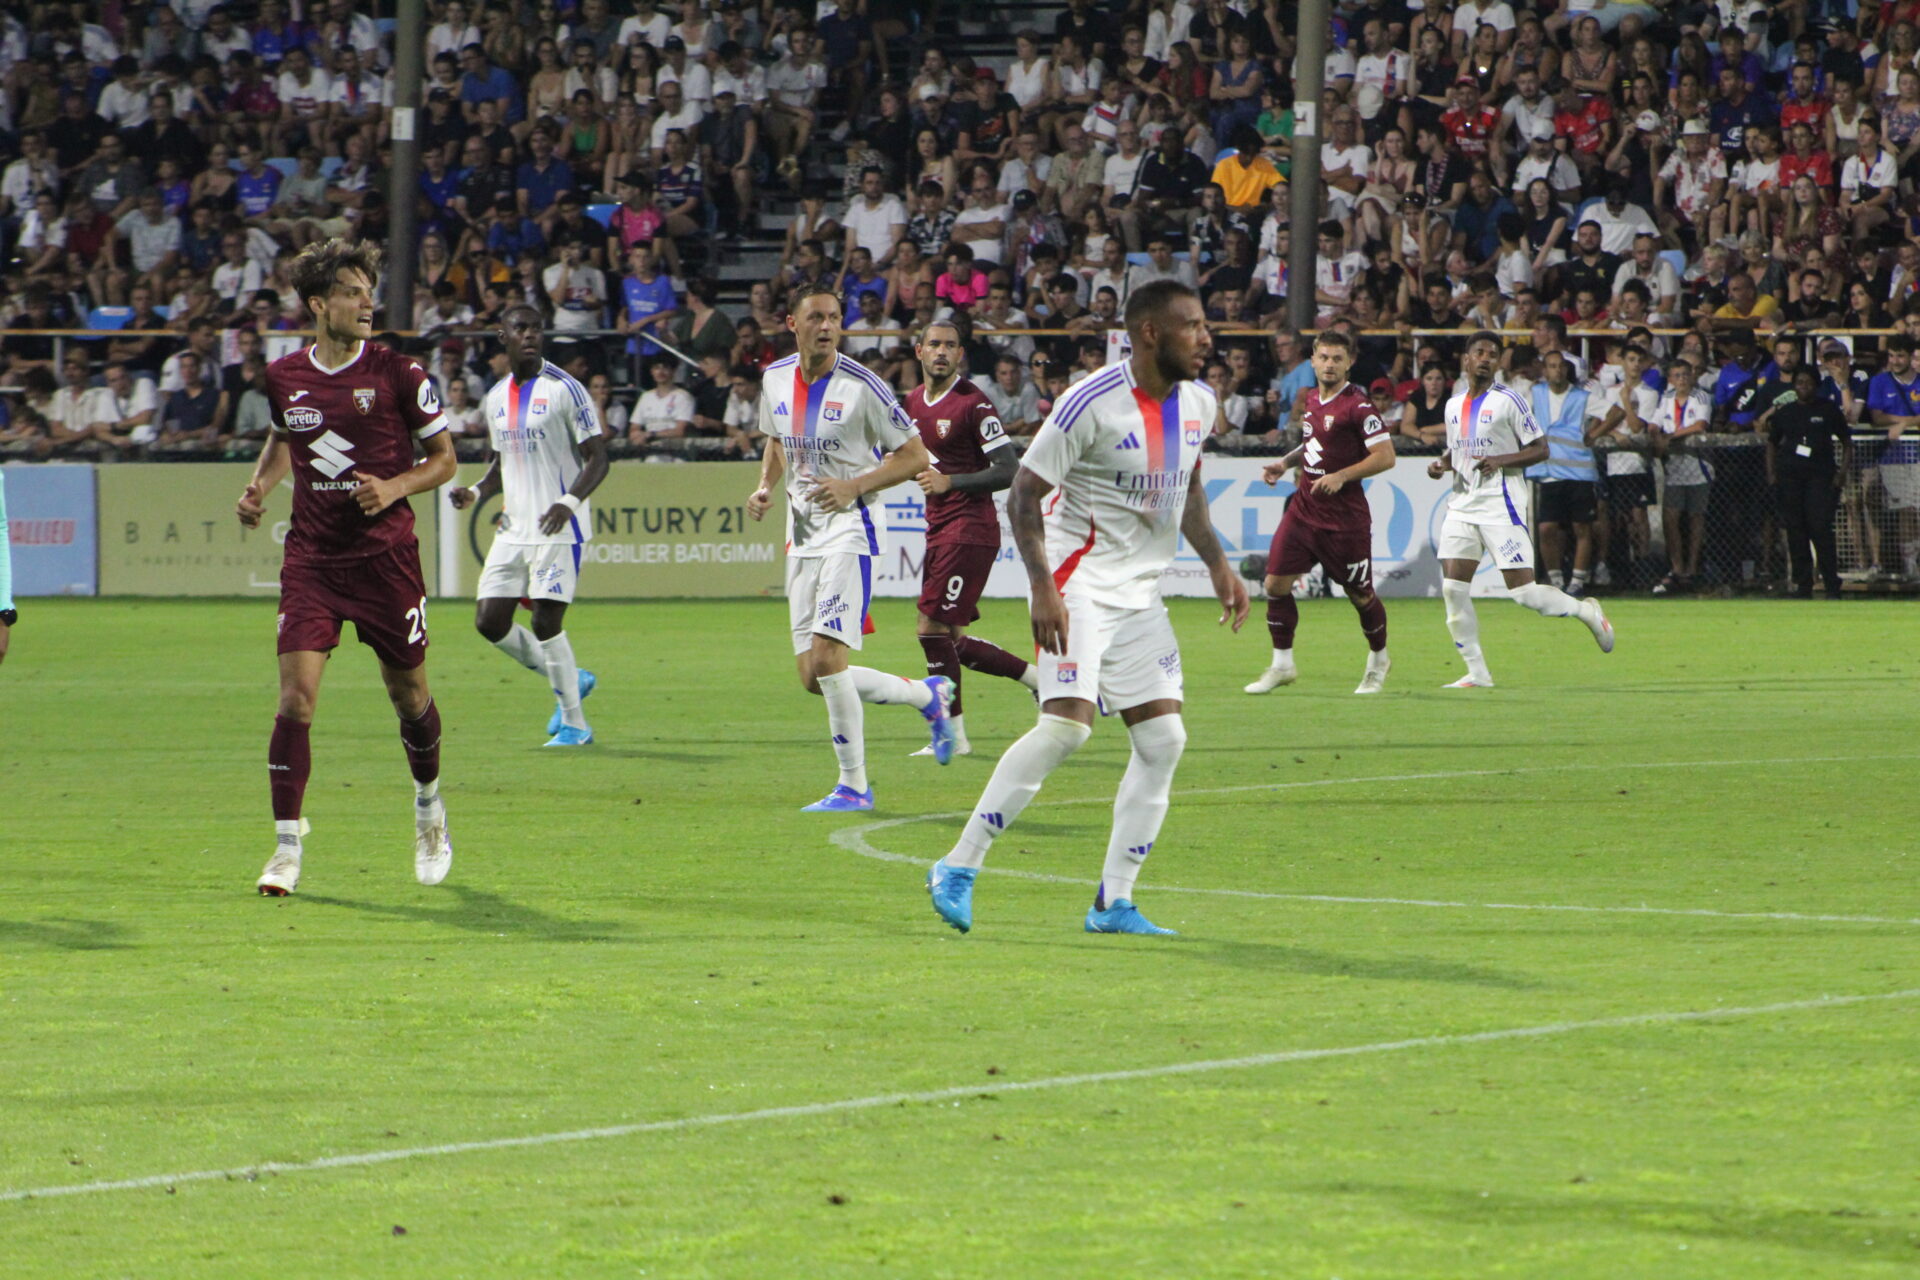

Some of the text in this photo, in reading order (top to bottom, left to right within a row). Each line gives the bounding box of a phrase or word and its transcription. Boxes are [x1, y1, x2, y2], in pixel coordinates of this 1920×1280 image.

[985, 421, 1000, 437] JD
[779, 433, 840, 451] mirates
[312, 481, 361, 491] SUZUKI
[1115, 469, 1190, 490] Emirate
[590, 506, 744, 534] NTURY 21
[582, 543, 775, 564] MOBILIER BATIGIMM
[1162, 566, 1211, 579] Plomb
[1347, 558, 1369, 583] 77
[945, 575, 964, 601] 9
